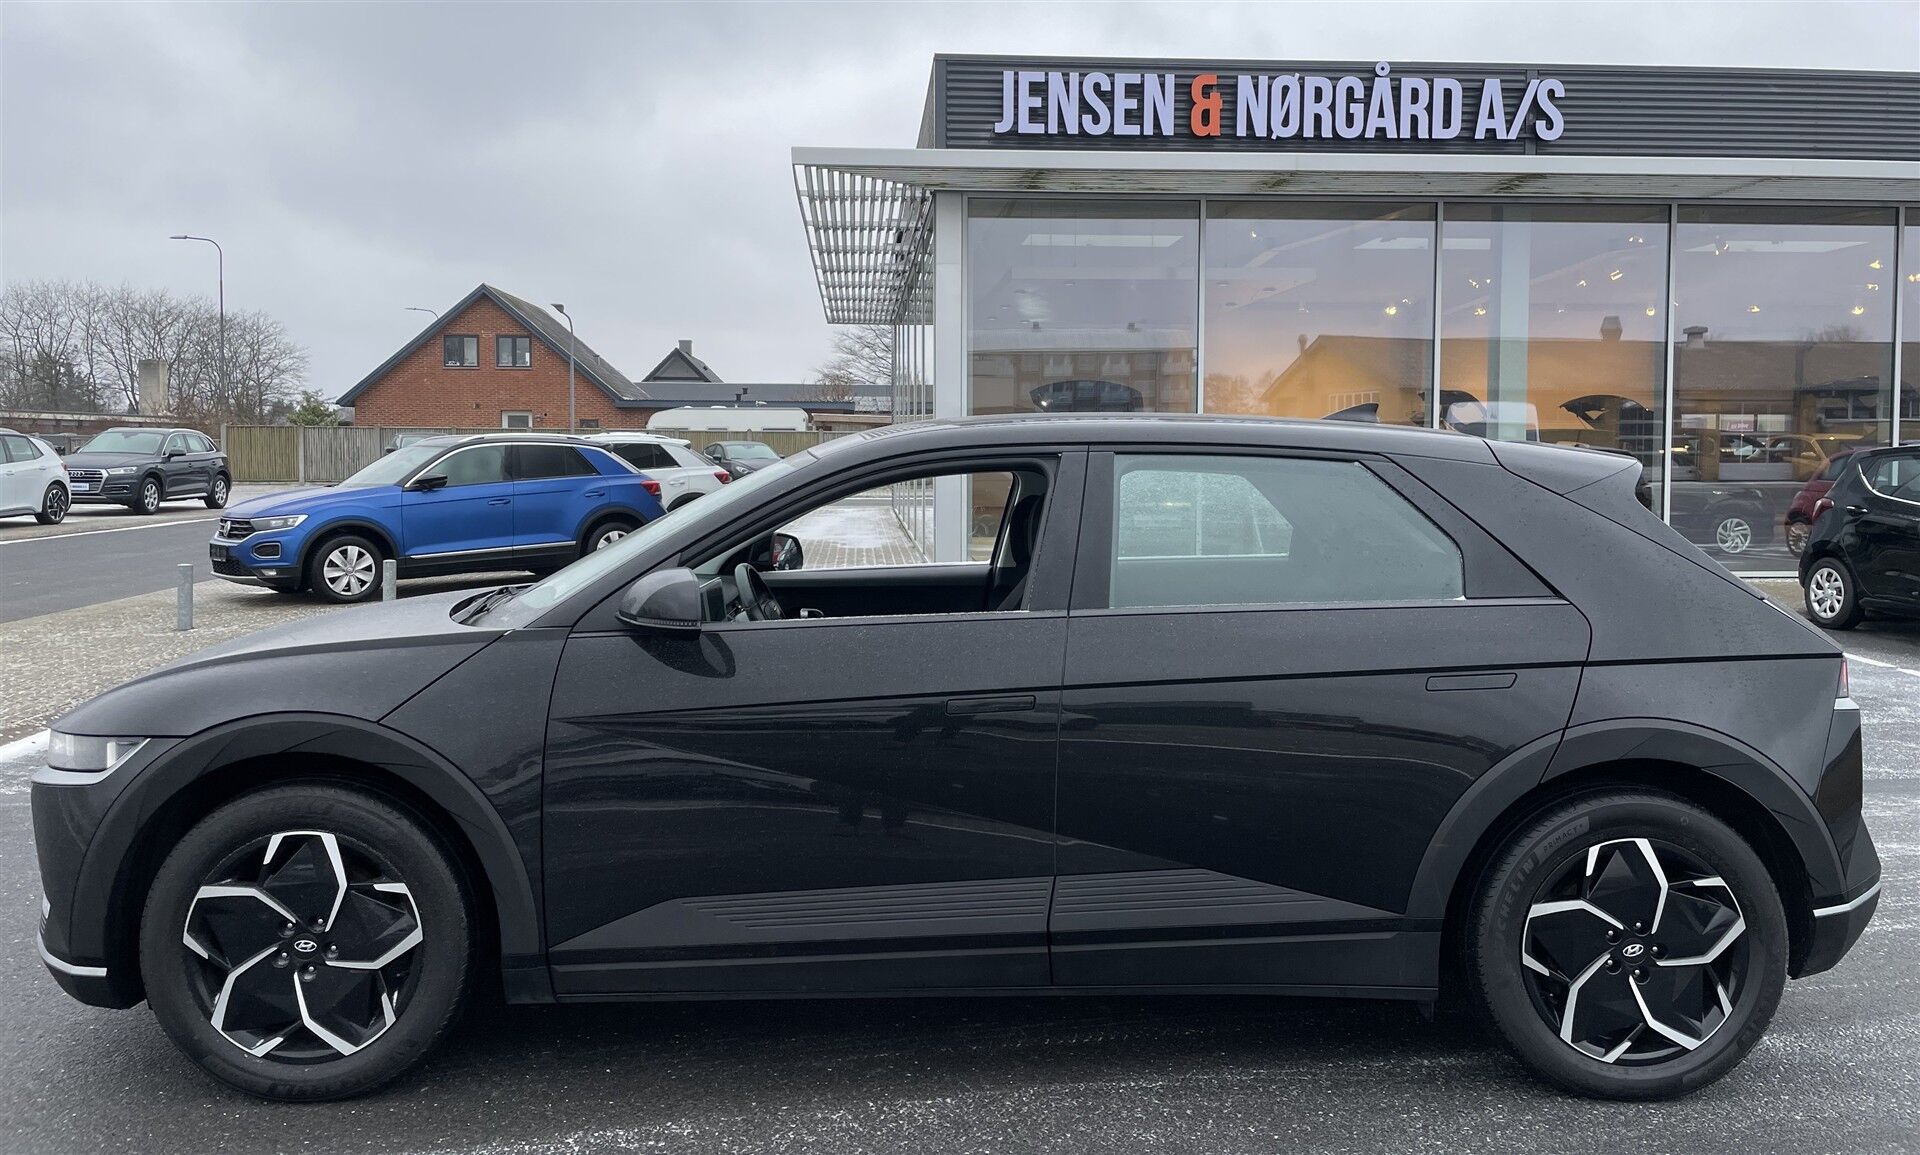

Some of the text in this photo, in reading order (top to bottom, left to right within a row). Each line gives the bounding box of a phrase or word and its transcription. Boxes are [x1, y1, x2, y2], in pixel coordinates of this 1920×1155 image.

[994, 61, 1566, 141] JENSEN & NØRGÅRD A/S
